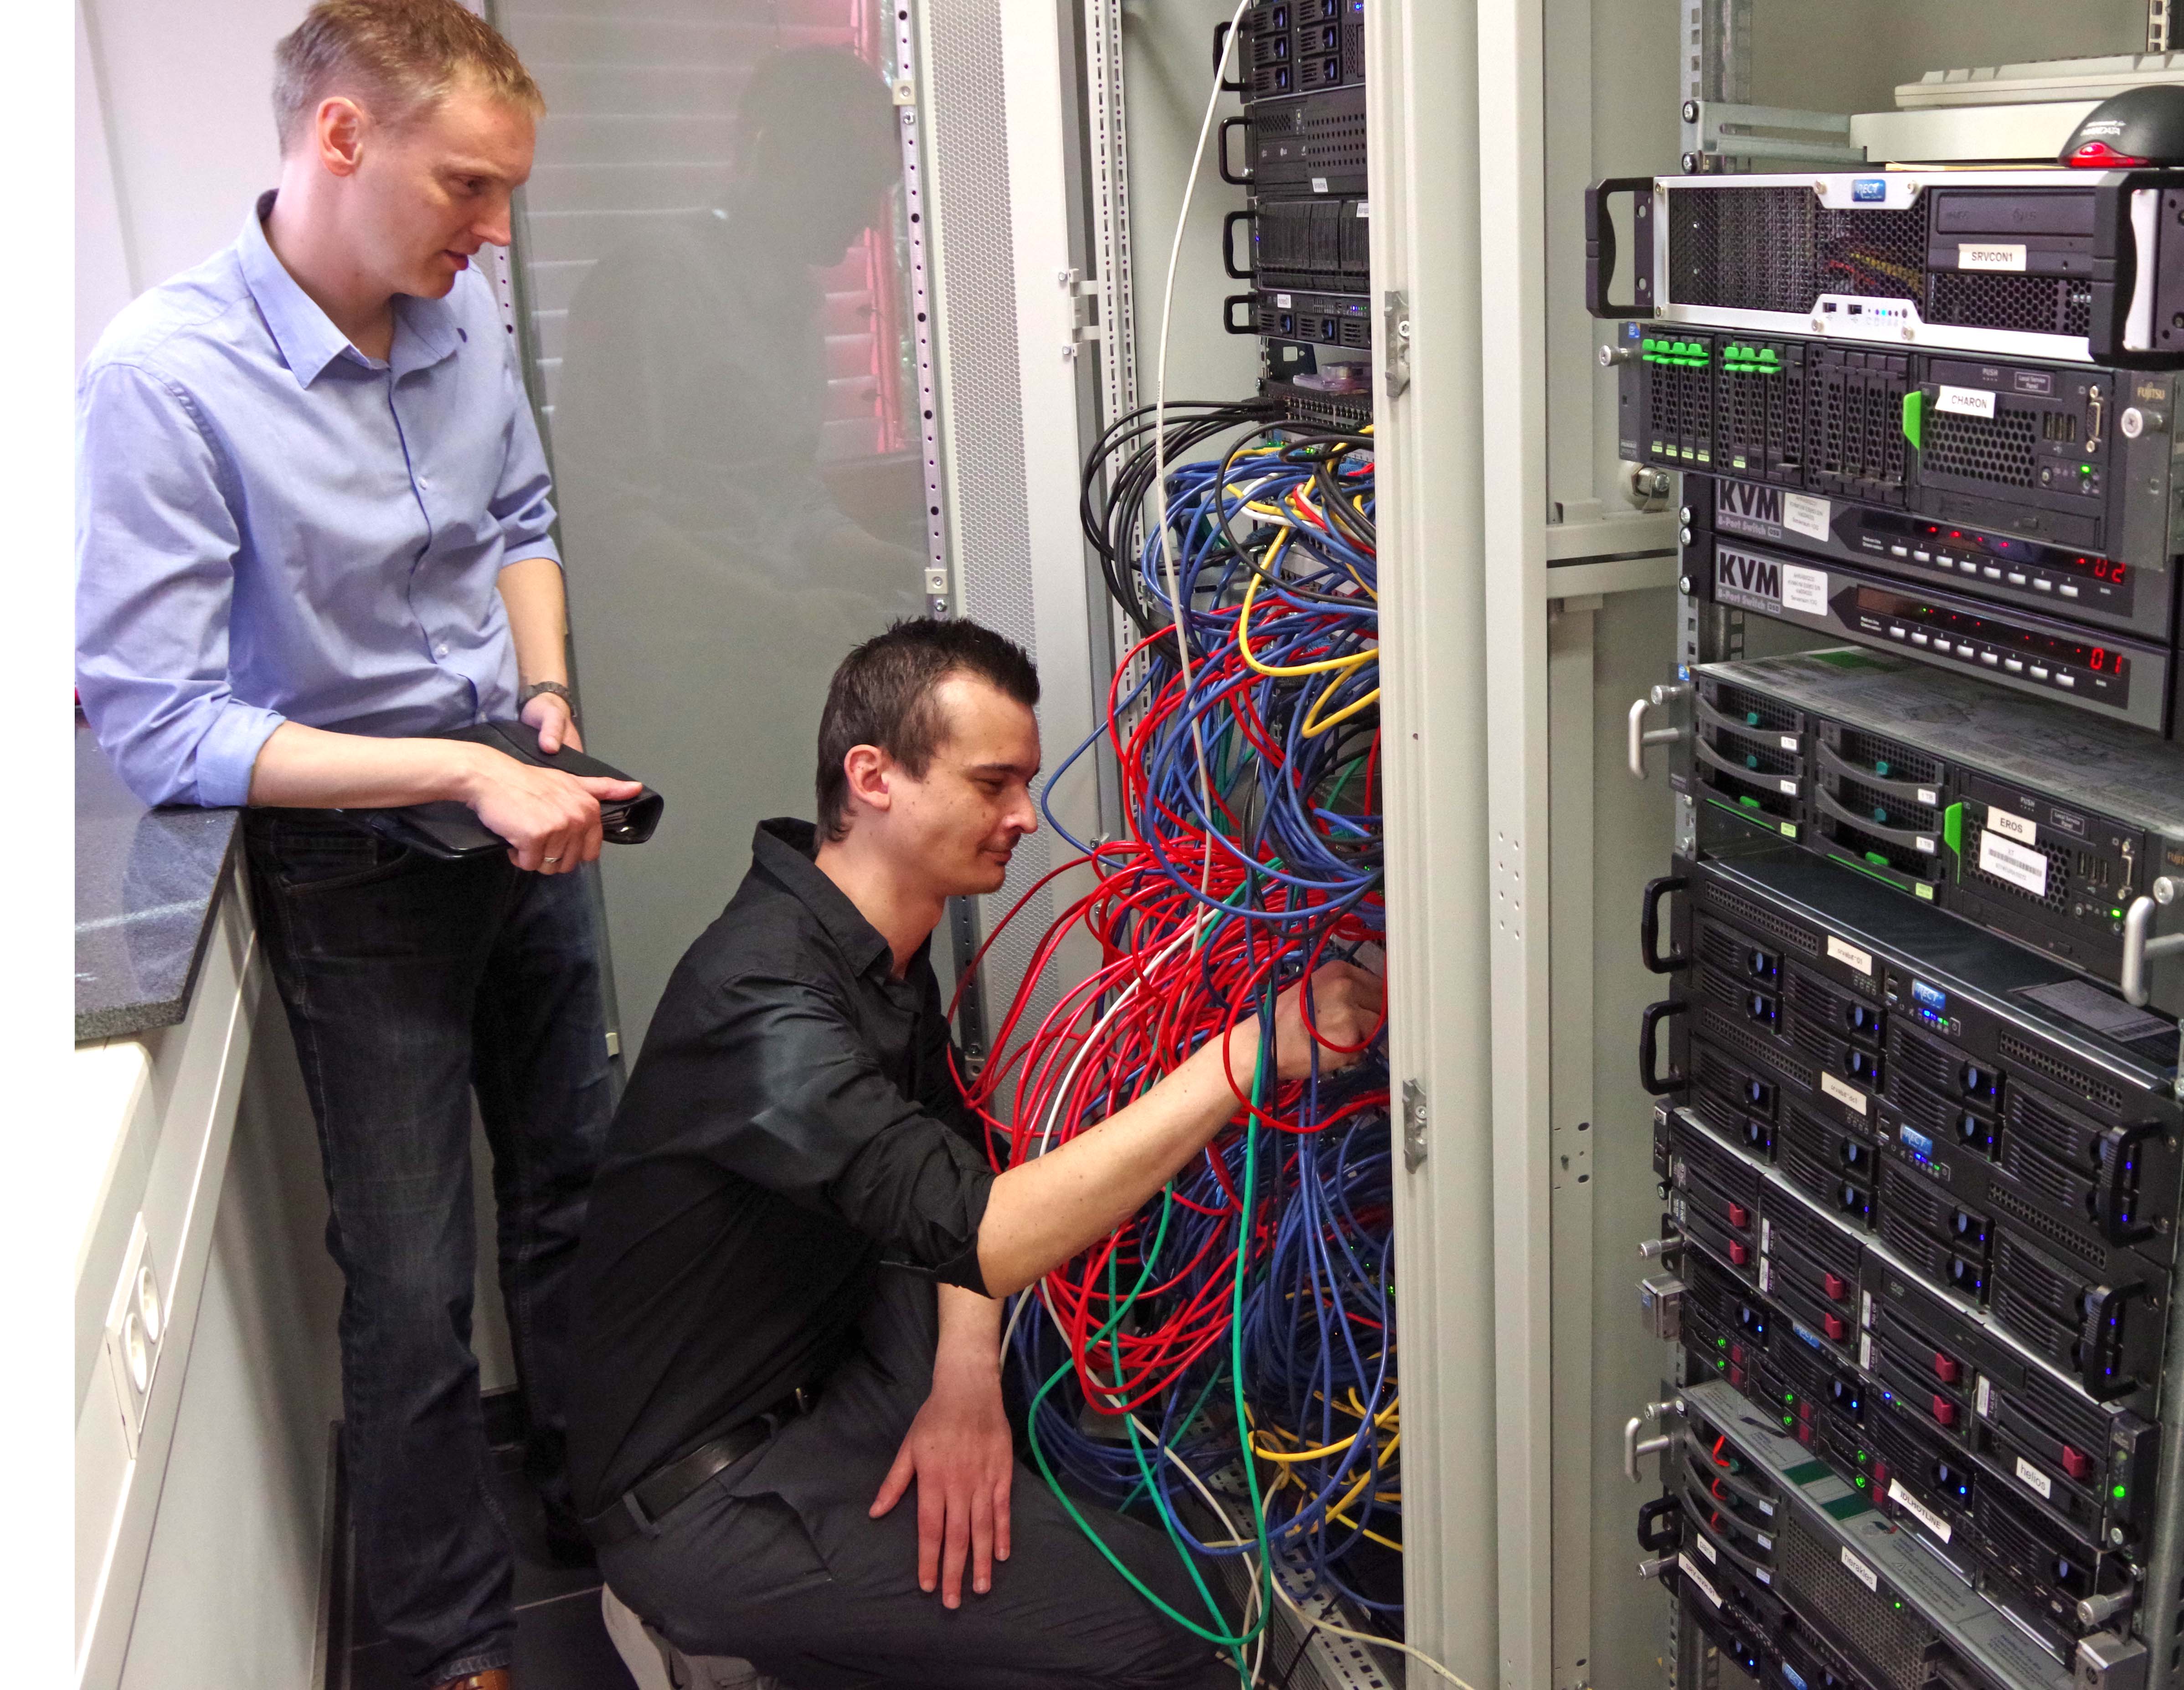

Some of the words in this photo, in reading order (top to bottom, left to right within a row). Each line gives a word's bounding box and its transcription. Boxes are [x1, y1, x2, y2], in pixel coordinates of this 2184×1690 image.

[1971, 251, 2013, 262] SRVCON1
[1952, 395, 1987, 408] CHARON
[2137, 381, 2165, 401] FUJITSU
[1720, 479, 1780, 523] KVM
[1720, 552, 1780, 598] KVM
[2090, 647, 2122, 674] 01
[2020, 796, 2035, 807] PUSH
[2000, 817, 2023, 833] EROS
[2020, 1463, 2046, 1491] helios
[1901, 1491, 1941, 1530] IDLHOTLINE
[1845, 1552, 1873, 1585] herakles
